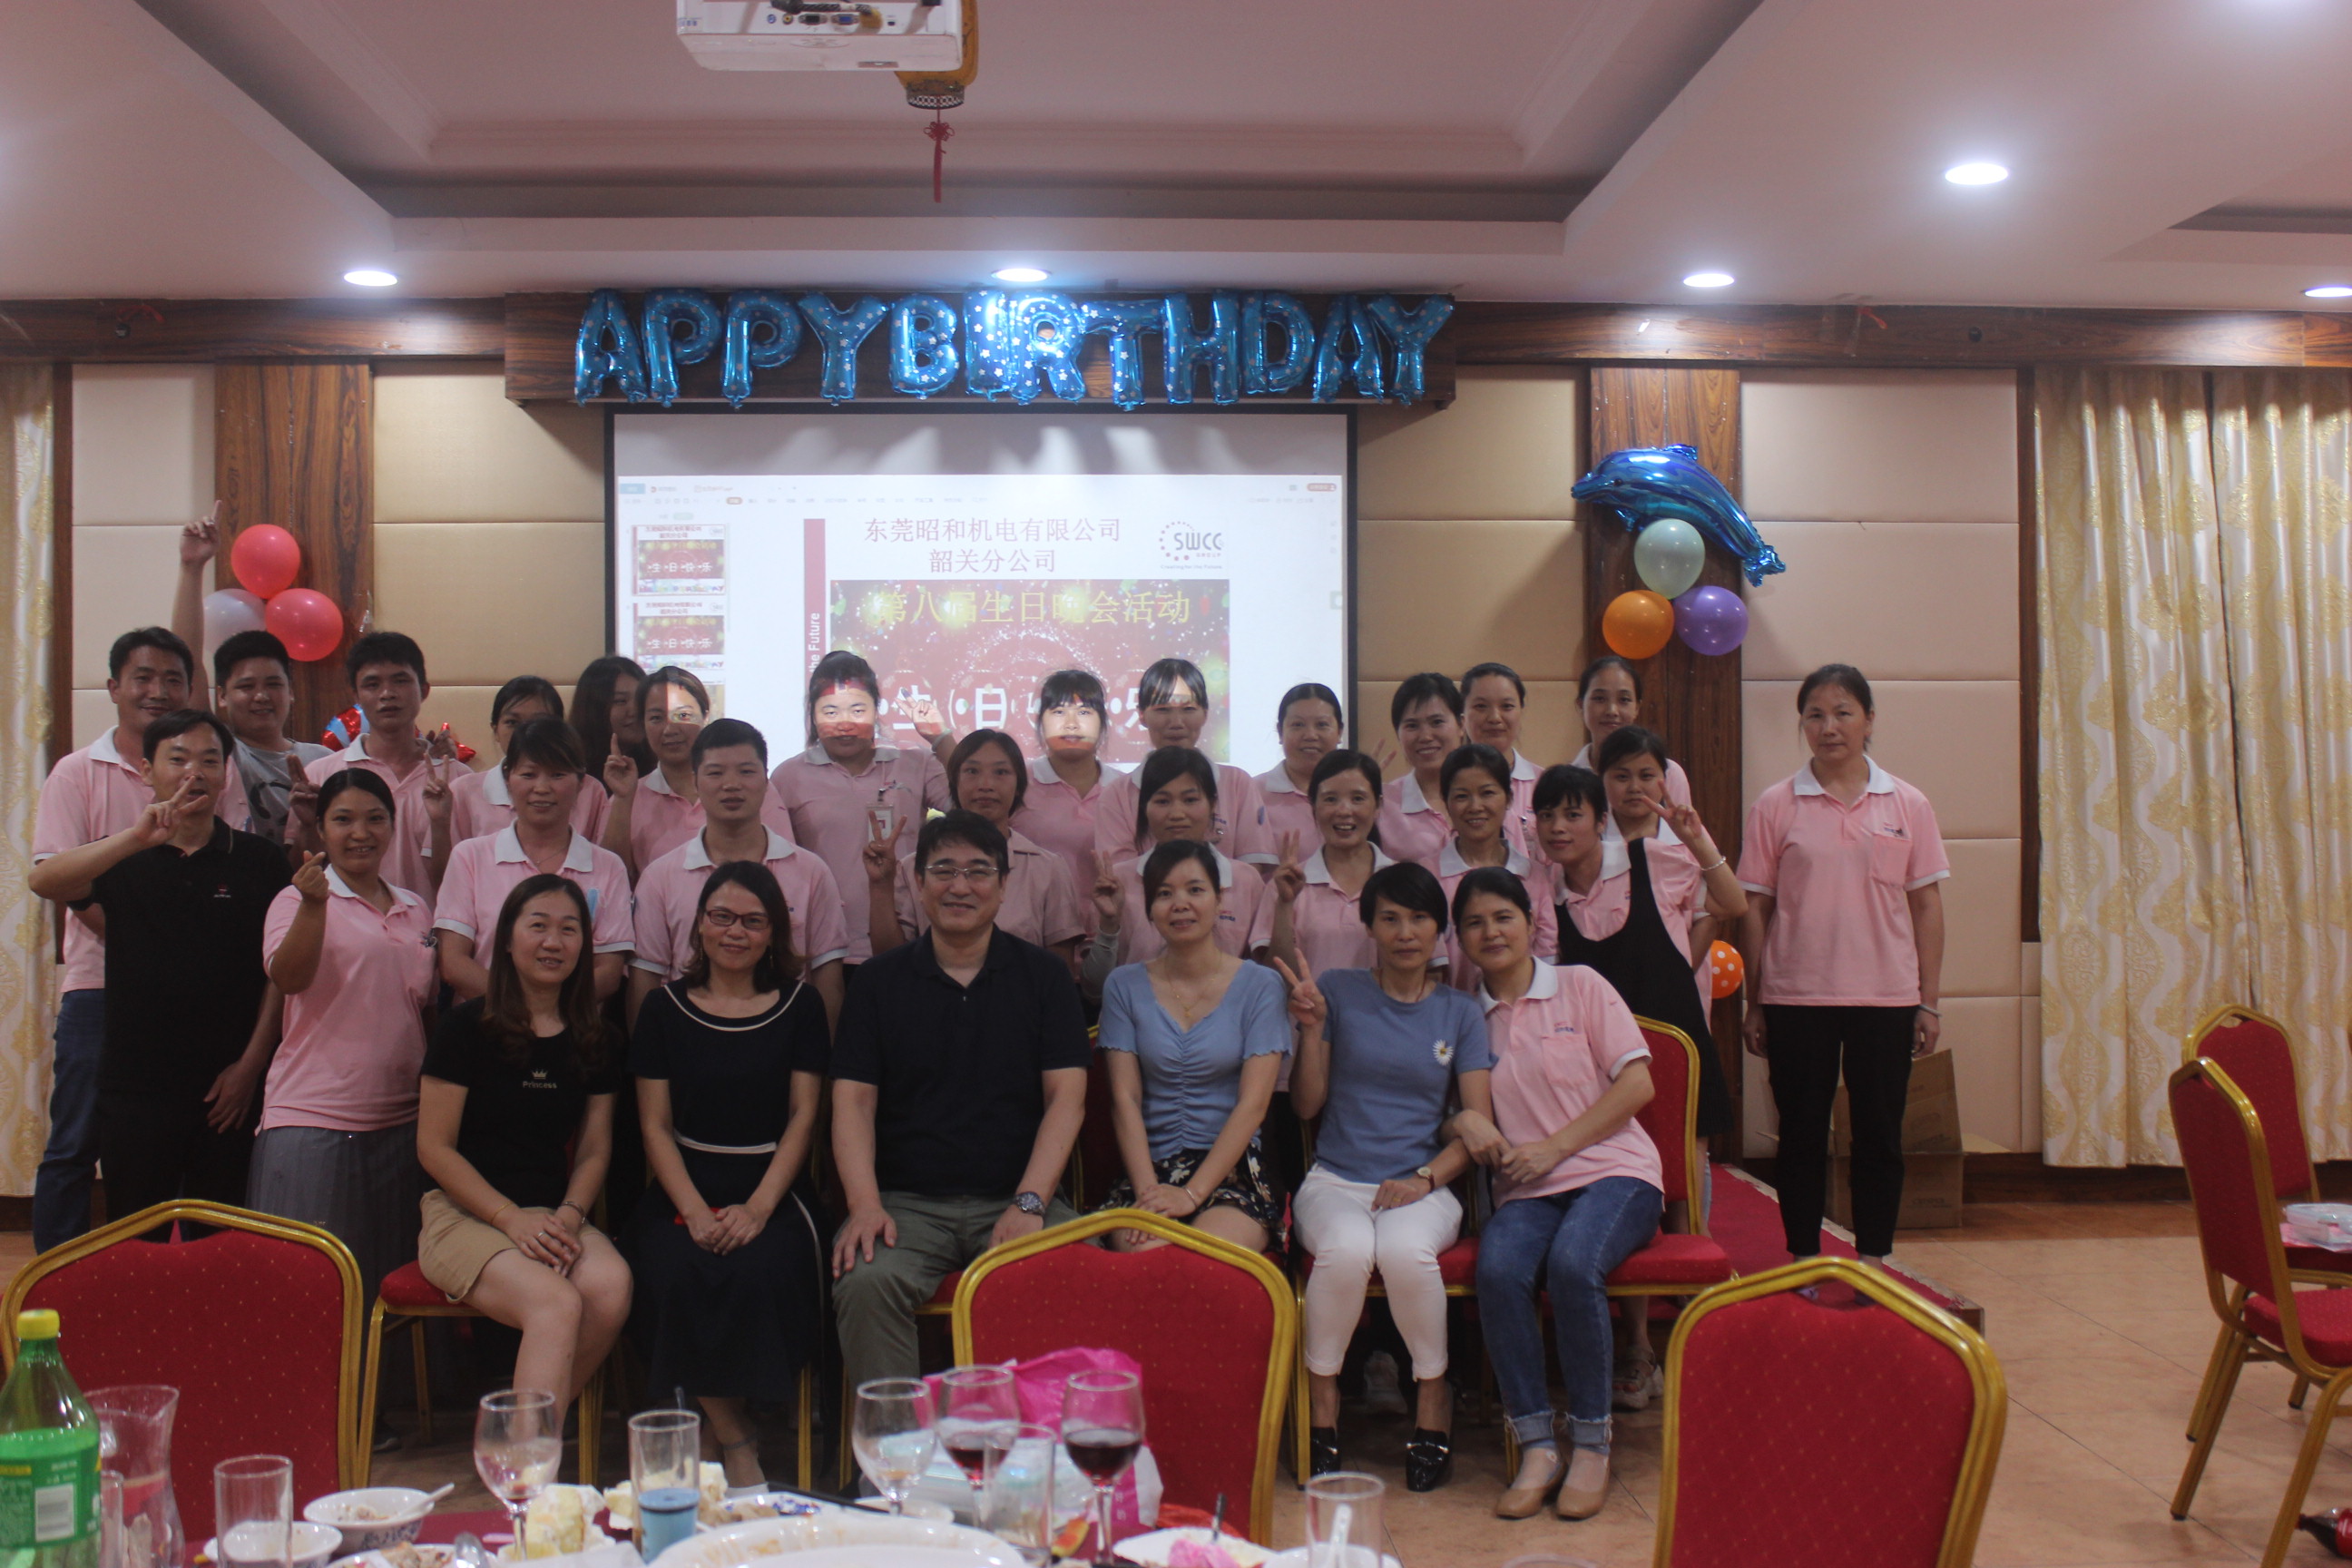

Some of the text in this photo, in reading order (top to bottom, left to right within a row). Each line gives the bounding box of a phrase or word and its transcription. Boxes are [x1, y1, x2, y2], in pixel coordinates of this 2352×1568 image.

[864, 517, 1121, 544] 东莞昭和机电有限公司
[1173, 532, 1222, 551] SWCC
[928, 548, 1056, 573] 韶关分公司
[878, 590, 1191, 625] 第八届生日晚会活动
[808, 612, 820, 651] Future
[523, 1081, 557, 1089] Princess
